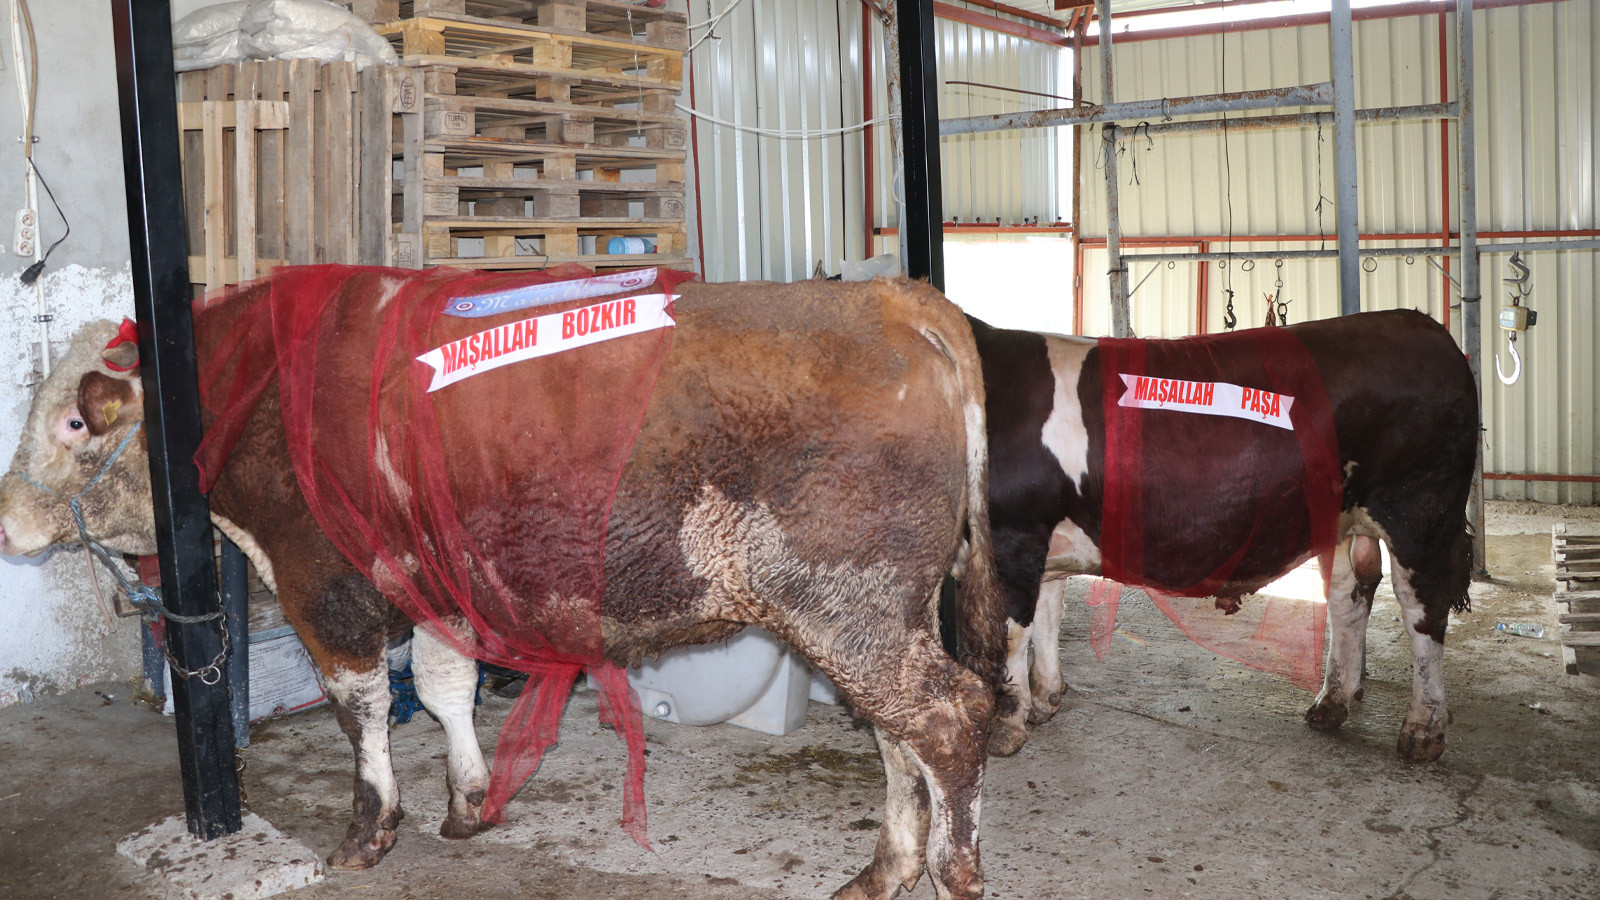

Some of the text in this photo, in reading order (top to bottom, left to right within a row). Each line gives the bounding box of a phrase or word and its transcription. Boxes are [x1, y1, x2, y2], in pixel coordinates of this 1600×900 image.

[441, 298, 636, 377] MAŞALLAH BOZKIR
[1134, 376, 1280, 419] MAŞALLAH PAŞA
